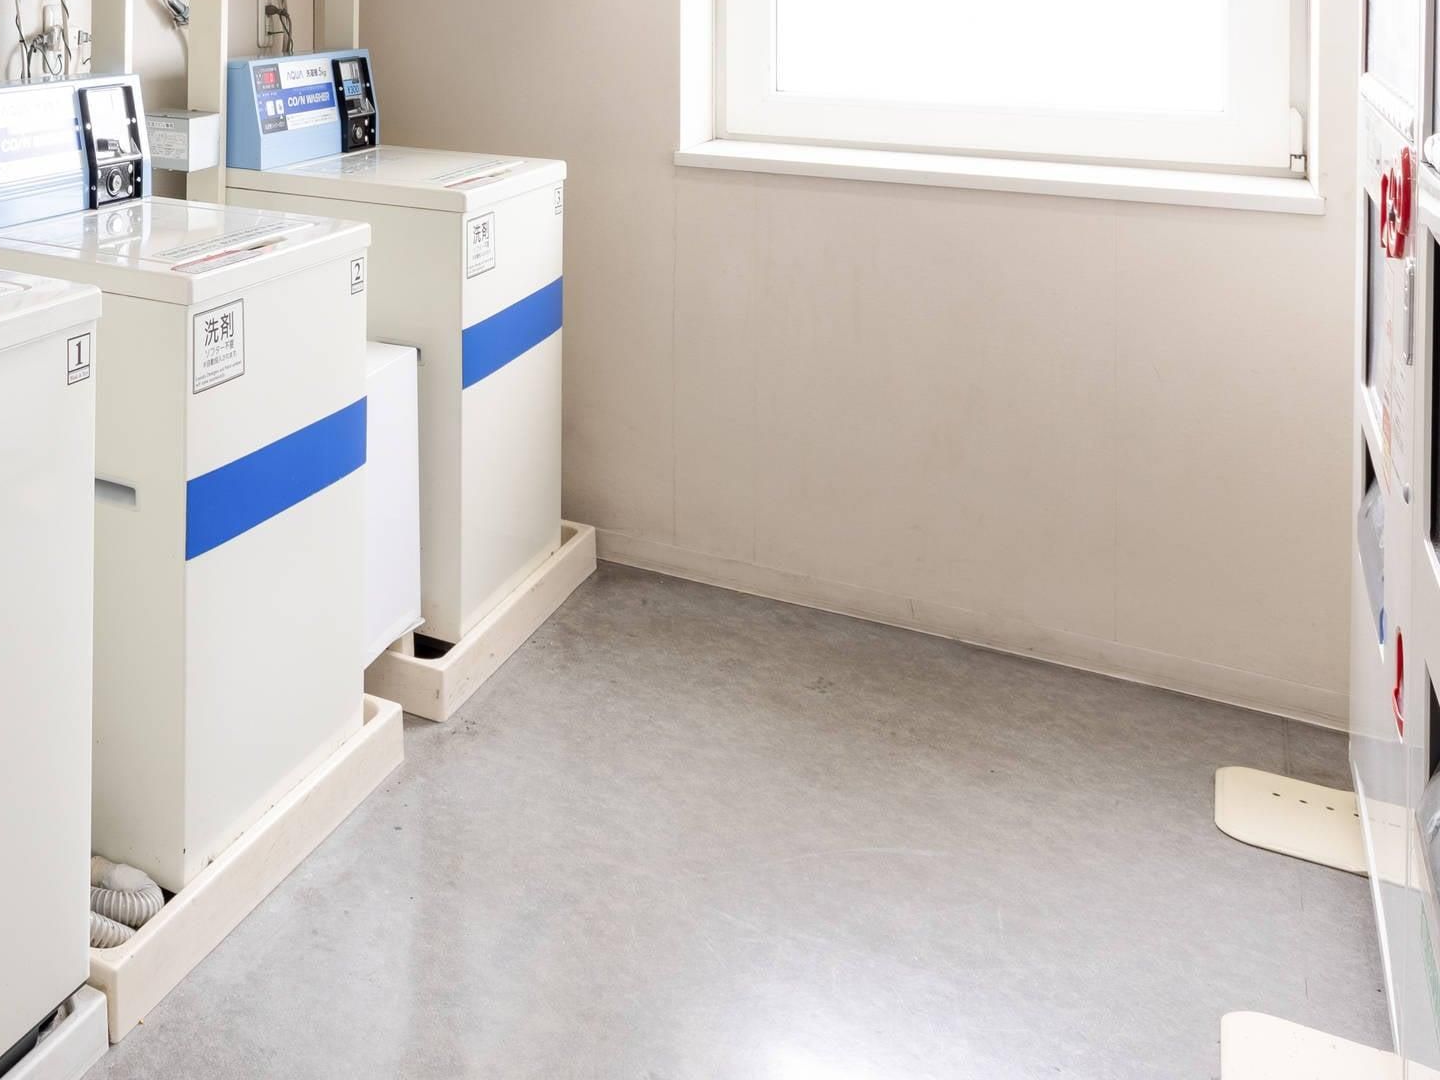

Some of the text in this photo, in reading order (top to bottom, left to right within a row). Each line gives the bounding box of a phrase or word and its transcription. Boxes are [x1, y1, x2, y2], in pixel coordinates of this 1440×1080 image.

[288, 92, 305, 107] COIN
[354, 262, 361, 281] 2
[204, 311, 234, 347] 洗剤
[75, 340, 83, 366] 1
